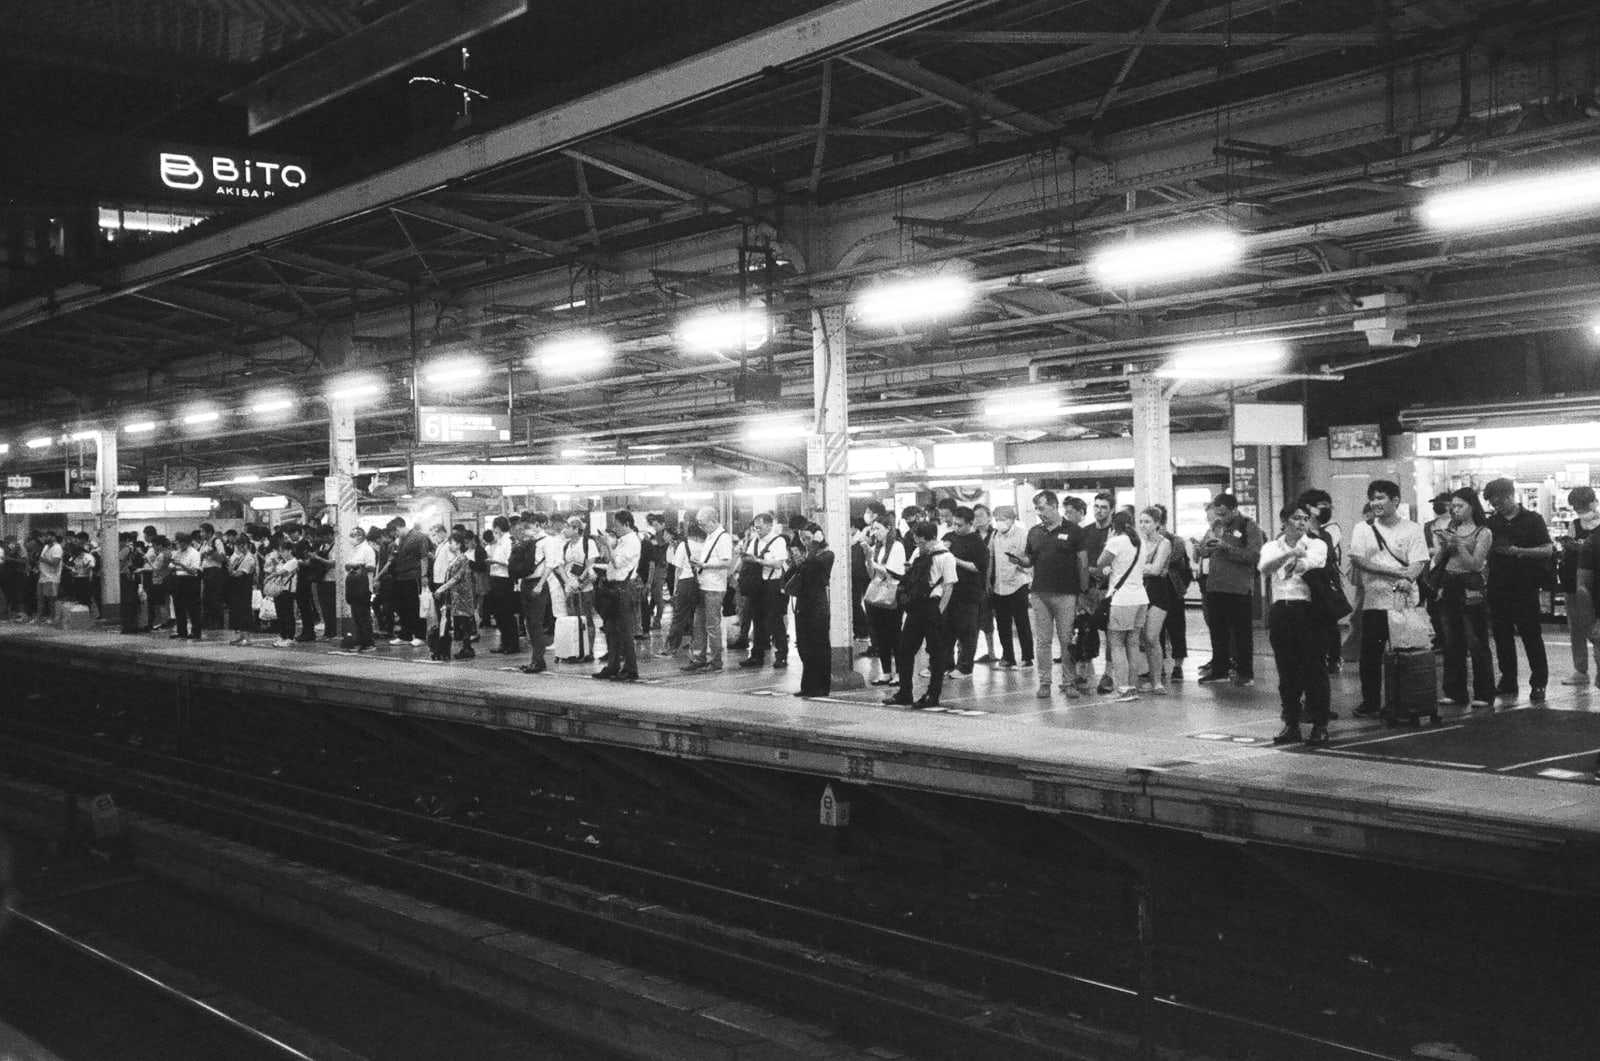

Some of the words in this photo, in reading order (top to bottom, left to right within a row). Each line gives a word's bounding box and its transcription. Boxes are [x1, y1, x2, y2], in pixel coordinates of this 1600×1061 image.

[212, 157, 306, 188] BiTO
[216, 186, 259, 197] AKIBA
[425, 415, 439, 438] 6
[71, 469, 78, 478] 6
